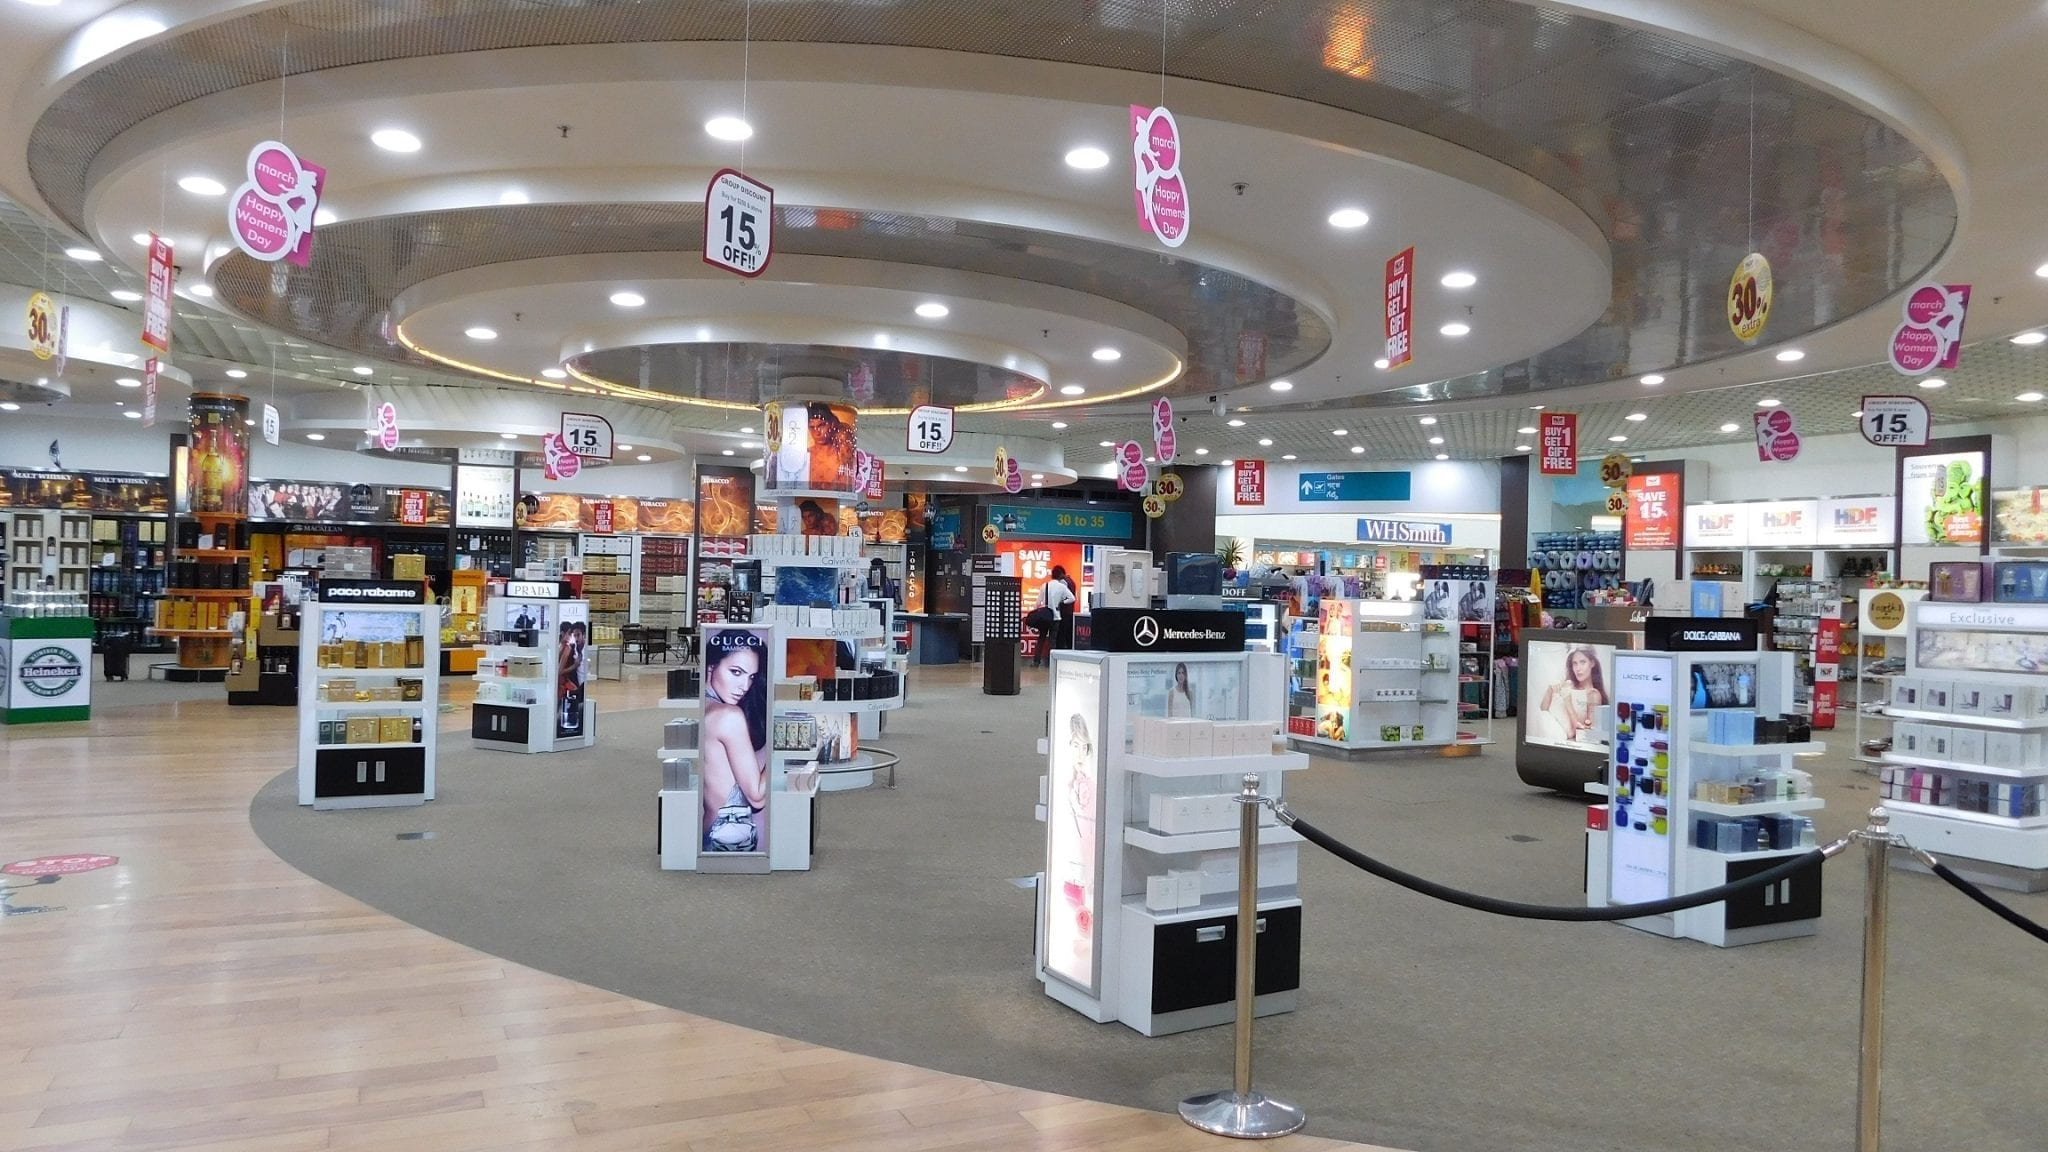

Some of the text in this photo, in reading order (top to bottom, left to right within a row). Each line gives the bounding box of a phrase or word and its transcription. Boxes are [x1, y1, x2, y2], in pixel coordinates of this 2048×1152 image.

[1152, 135, 1176, 150] march
[258, 162, 295, 185] march
[721, 177, 767, 202] GROUP DISCOUNT
[1155, 184, 1180, 201] Happy
[246, 195, 284, 222] Happy
[1152, 202, 1186, 219] Womens
[237, 208, 288, 238] Womens
[1163, 221, 1179, 238] Day
[247, 229, 272, 248] Day
[723, 245, 756, 270] OFF!!
[1388, 273, 1408, 309] BUY 1
[1388, 296, 1401, 318] GET
[1910, 300, 1942, 309] march
[1390, 312, 1405, 336] GIFT
[1901, 331, 1934, 342] Happy
[1387, 330, 1408, 360] FREE
[1894, 343, 1938, 352] Womens
[1903, 355, 1924, 366] Day
[1545, 427, 1571, 446] BUY 1
[1545, 437, 1562, 447] GET
[1873, 434, 1907, 442] OFF!!
[571, 446, 597, 455] OFF!!
[920, 441, 942, 450] OFF!!
[1548, 447, 1569, 457] GIFT
[1543, 457, 1573, 469] FREE
[1253, 470, 1260, 484] 1
[1241, 484, 1258, 492] GIFT
[1237, 492, 1261, 501] FREE
[1637, 491, 1666, 501] SAVE
[1057, 514, 1105, 528] 30 to 35
[1698, 514, 1734, 530] HDF
[1763, 511, 1802, 527] HDF
[1834, 507, 1877, 525] HDF
[1365, 519, 1446, 543] WHSmith
[821, 557, 845, 566] Calvin
[1019, 550, 1051, 560] SAVE
[328, 587, 416, 597] paco rabanne
[515, 586, 551, 596] PRADA
[1950, 612, 2015, 625] Exclusive
[1163, 628, 1226, 639] Mercedes-Benz
[711, 636, 762, 646] GUCCI
[23, 667, 78, 677] Heineken
